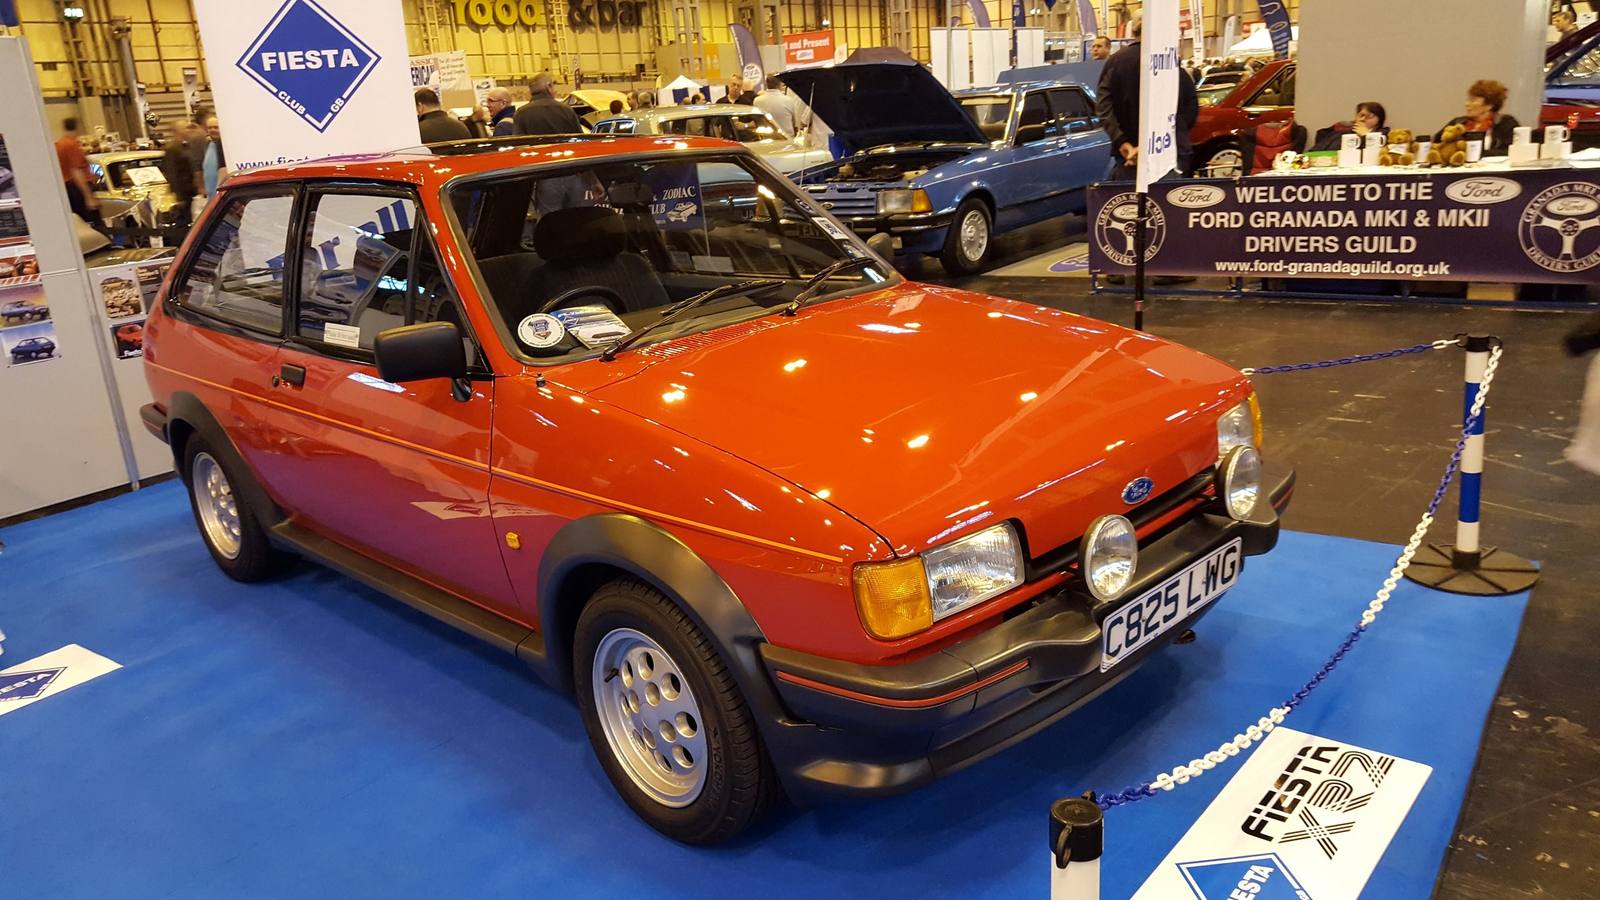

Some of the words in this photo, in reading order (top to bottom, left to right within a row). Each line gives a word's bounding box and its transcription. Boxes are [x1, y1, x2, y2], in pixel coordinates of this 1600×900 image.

[261, 49, 360, 71] FIESTA
[278, 91, 306, 115] CLUB
[330, 97, 345, 113] GB
[662, 185, 697, 201] ZODIAC
[1178, 188, 1212, 203] Ford
[1236, 185, 1347, 203] WELCOME
[1351, 184, 1382, 202] TO
[1385, 182, 1433, 201] THE
[1461, 181, 1505, 198] Ford
[1098, 195, 1128, 226] GRANADA
[1524, 184, 1570, 222] GRANADA
[1188, 211, 1244, 229] FORD
[1250, 210, 1359, 228] GRANADA
[1364, 209, 1407, 227] MKI
[1413, 209, 1431, 227] &
[1437, 208, 1490, 227] MKII
[1103, 244, 1134, 264] DRIVERS
[1245, 236, 1339, 253] DRIVERS
[1345, 235, 1417, 253] GUILD
[1215, 259, 1450, 276] www.ford-granadaguild.org.uk
[1527, 246, 1570, 271] DRIVERS
[1105, 579, 1180, 657] C825
[1187, 545, 1238, 609] LWG
[1241, 746, 1340, 842] FIESTA
[1278, 750, 1395, 860] XR2
